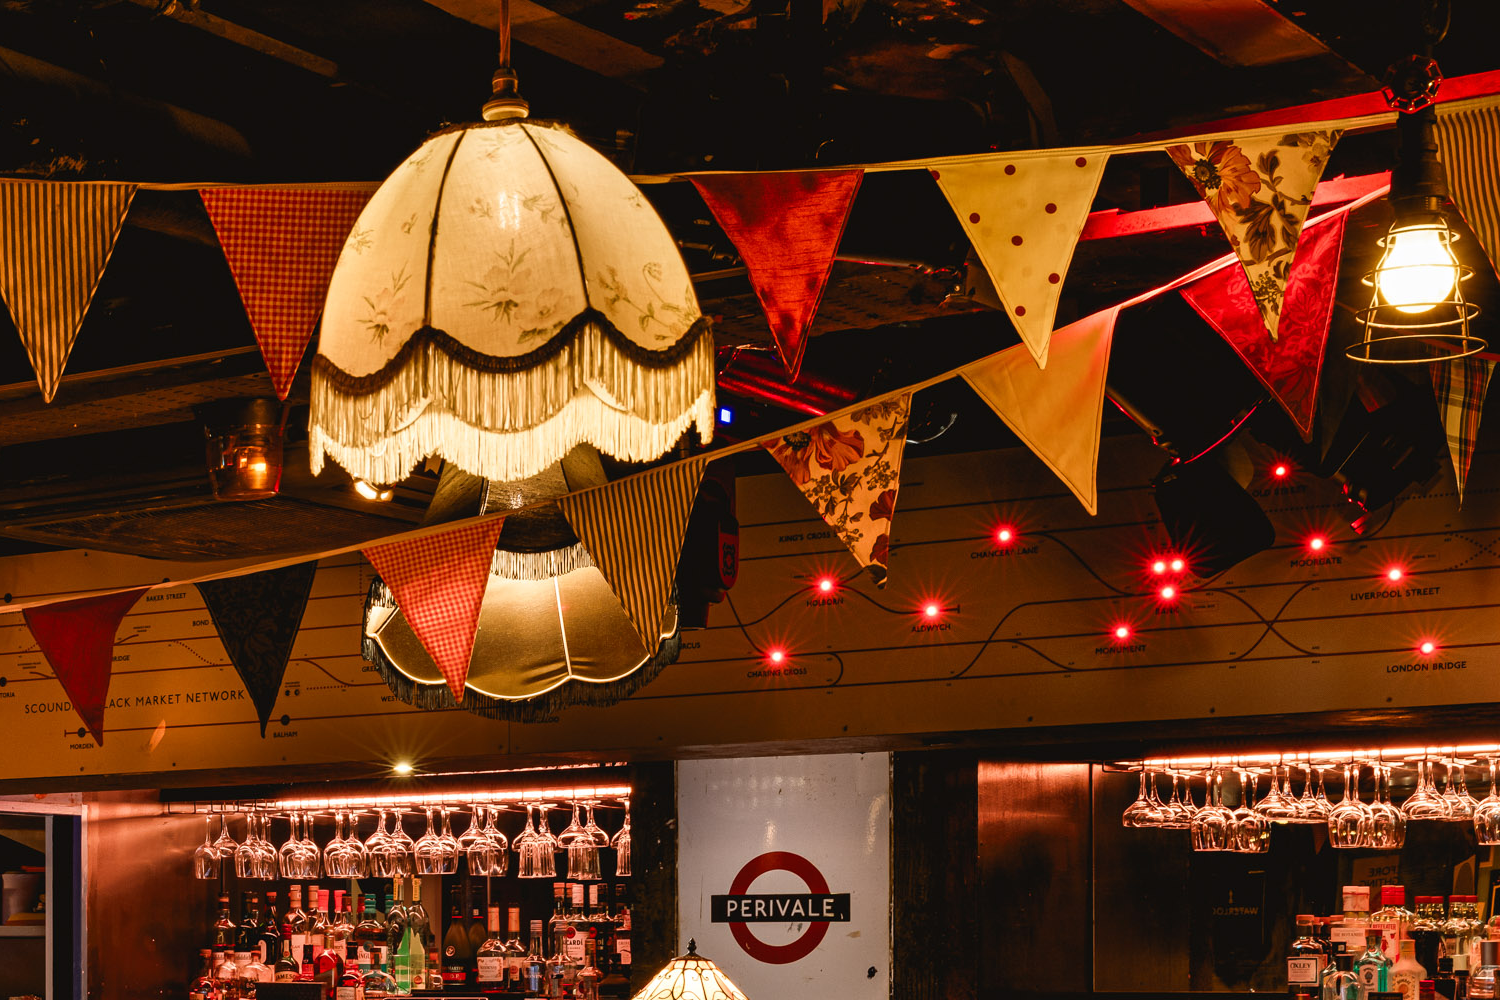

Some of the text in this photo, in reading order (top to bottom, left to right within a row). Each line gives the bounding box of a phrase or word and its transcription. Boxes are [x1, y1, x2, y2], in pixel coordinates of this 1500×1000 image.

[1252, 485, 1308, 498] OLD STREET
[778, 533, 804, 543] KING'S
[806, 531, 831, 540] CROSS
[970, 545, 1040, 560] CHANCERY LANE
[1289, 556, 1343, 568] MOORGATE
[146, 592, 187, 602] BAKER STREET
[1350, 586, 1441, 601] LIVERPOOL STREET
[806, 598, 844, 607] HOLBORN
[192, 619, 210, 627] BOND
[911, 622, 951, 634] ALDWYCH
[1095, 644, 1147, 655] MONUMENT
[1386, 660, 1467, 673] LONDON BRIDGE
[747, 667, 808, 679] CHARING CROSS
[135, 693, 181, 708] MARKET
[186, 689, 245, 704] NETWORK
[272, 730, 298, 738] BALHAM
[726, 898, 835, 918] PERIVALE
